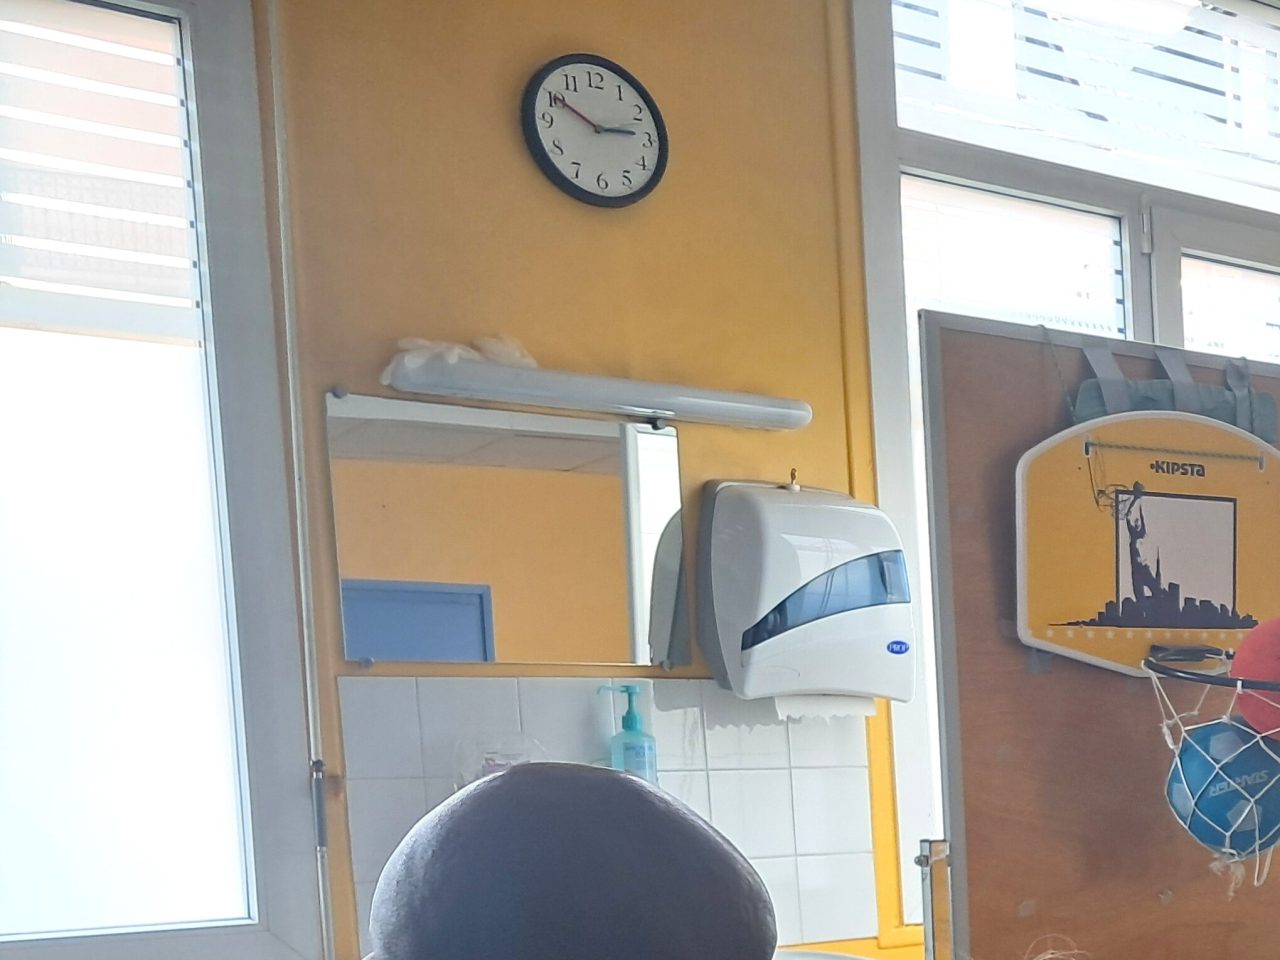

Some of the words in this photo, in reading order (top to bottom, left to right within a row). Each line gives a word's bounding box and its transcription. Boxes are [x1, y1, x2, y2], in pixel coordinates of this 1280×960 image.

[563, 74, 578, 92] 11
[586, 71, 604, 90] 12
[548, 91, 566, 108] 10
[616, 85, 623, 101] 1
[541, 112, 554, 128] 9
[633, 104, 643, 121] 2
[551, 139, 564, 156] 8
[642, 131, 653, 148] 3
[571, 161, 581, 179] 7
[635, 155, 647, 171] 4
[596, 172, 608, 190] 6
[622, 170, 632, 187] 5
